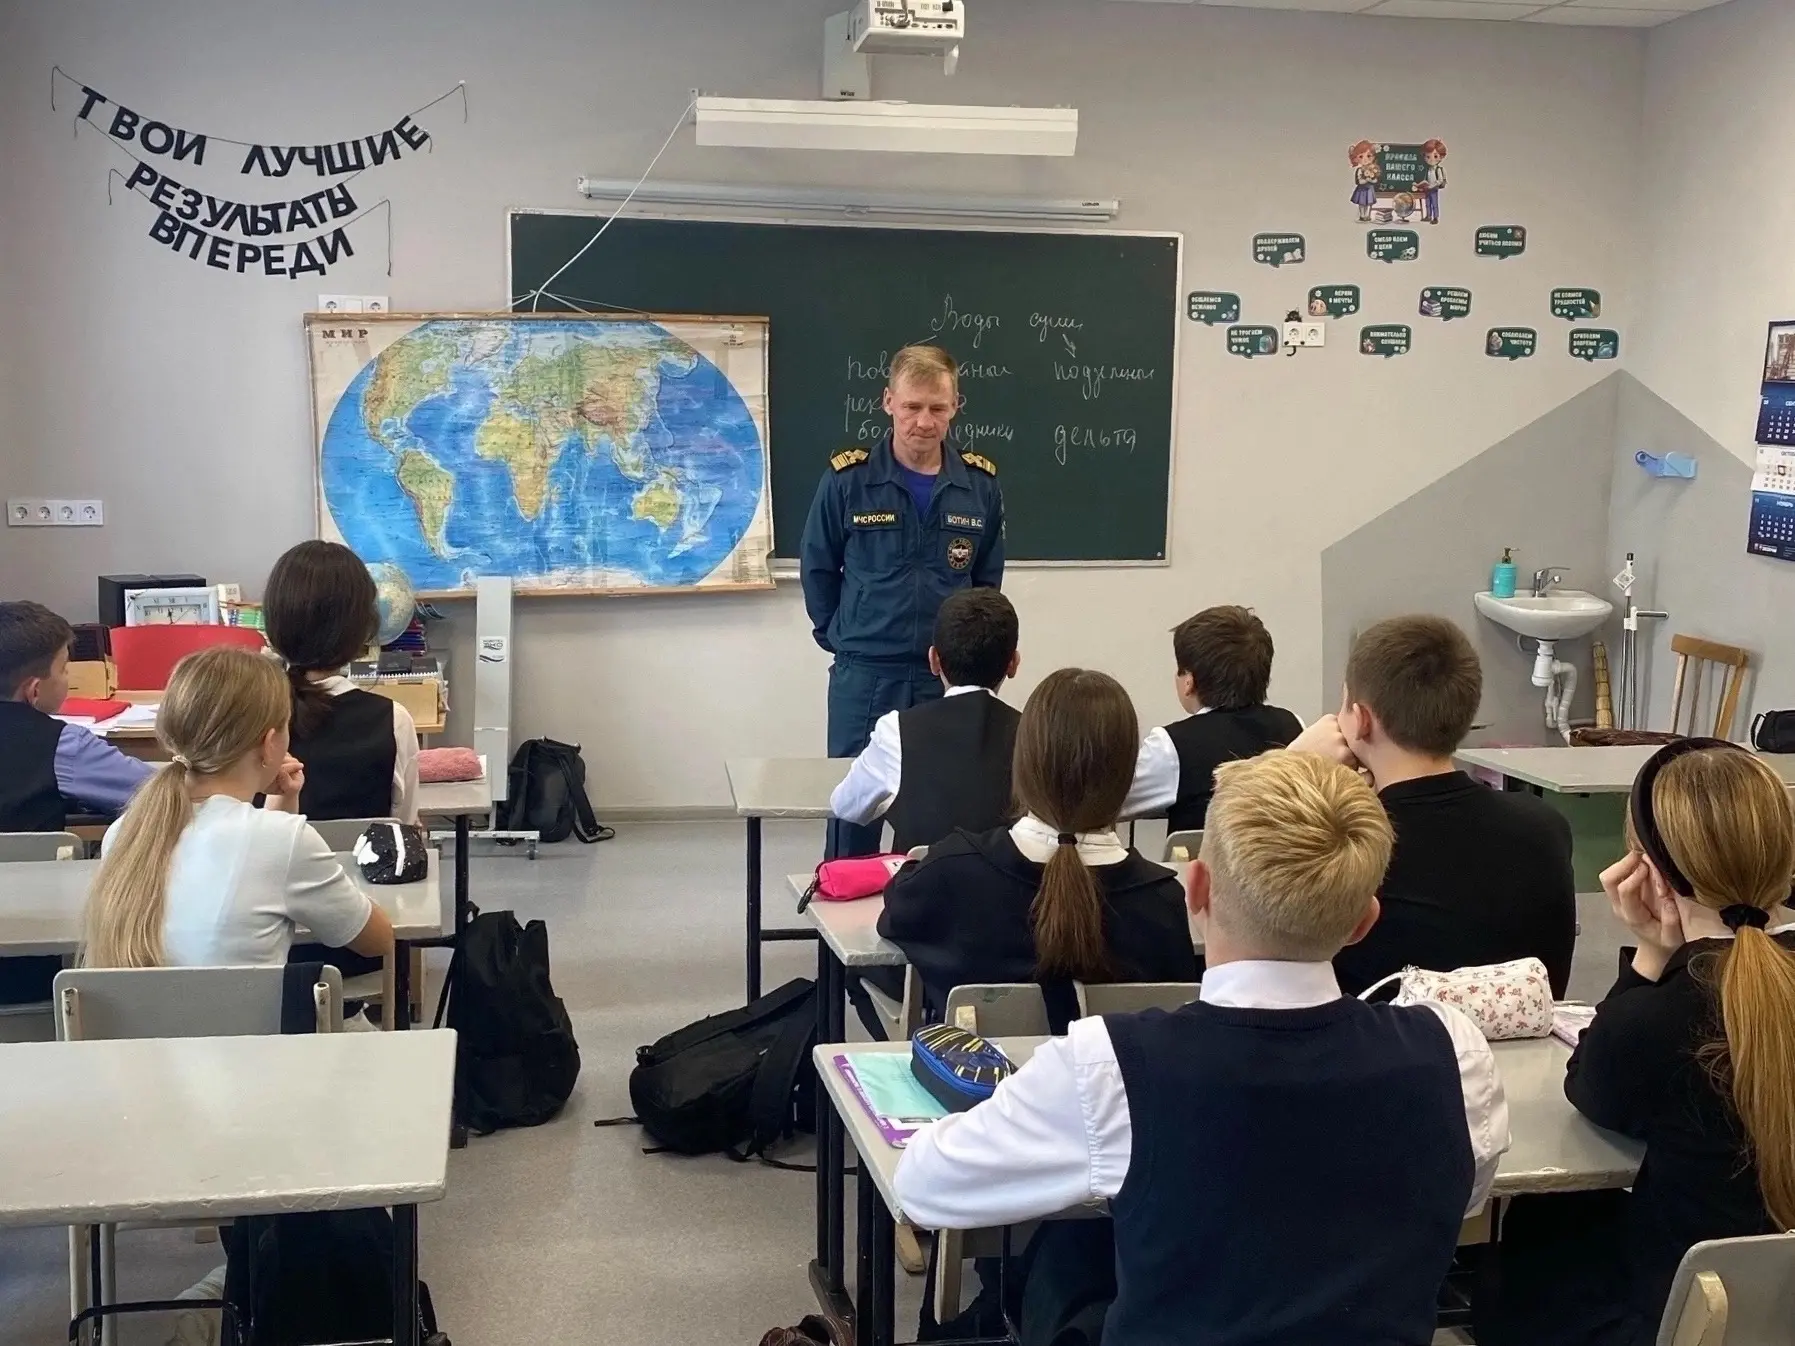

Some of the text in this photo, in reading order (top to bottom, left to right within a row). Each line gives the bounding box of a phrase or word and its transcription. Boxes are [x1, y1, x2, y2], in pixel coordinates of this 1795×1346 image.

[78, 86, 429, 178] ТВОИ ЛУЧШИЕ
[1386, 163, 1415, 171] НАШЕГО
[1387, 173, 1414, 181] КЛАССА
[126, 161, 358, 236] РЕЗУЛЬТАТЫ
[149, 210, 354, 280] ВПЕРЕДИ
[322, 329, 368, 339] МИР
[1054, 424, 1137, 466] дельта
[853, 514, 895, 524] МЧС РОССИИ
[947, 515, 970, 526] БОТИН
